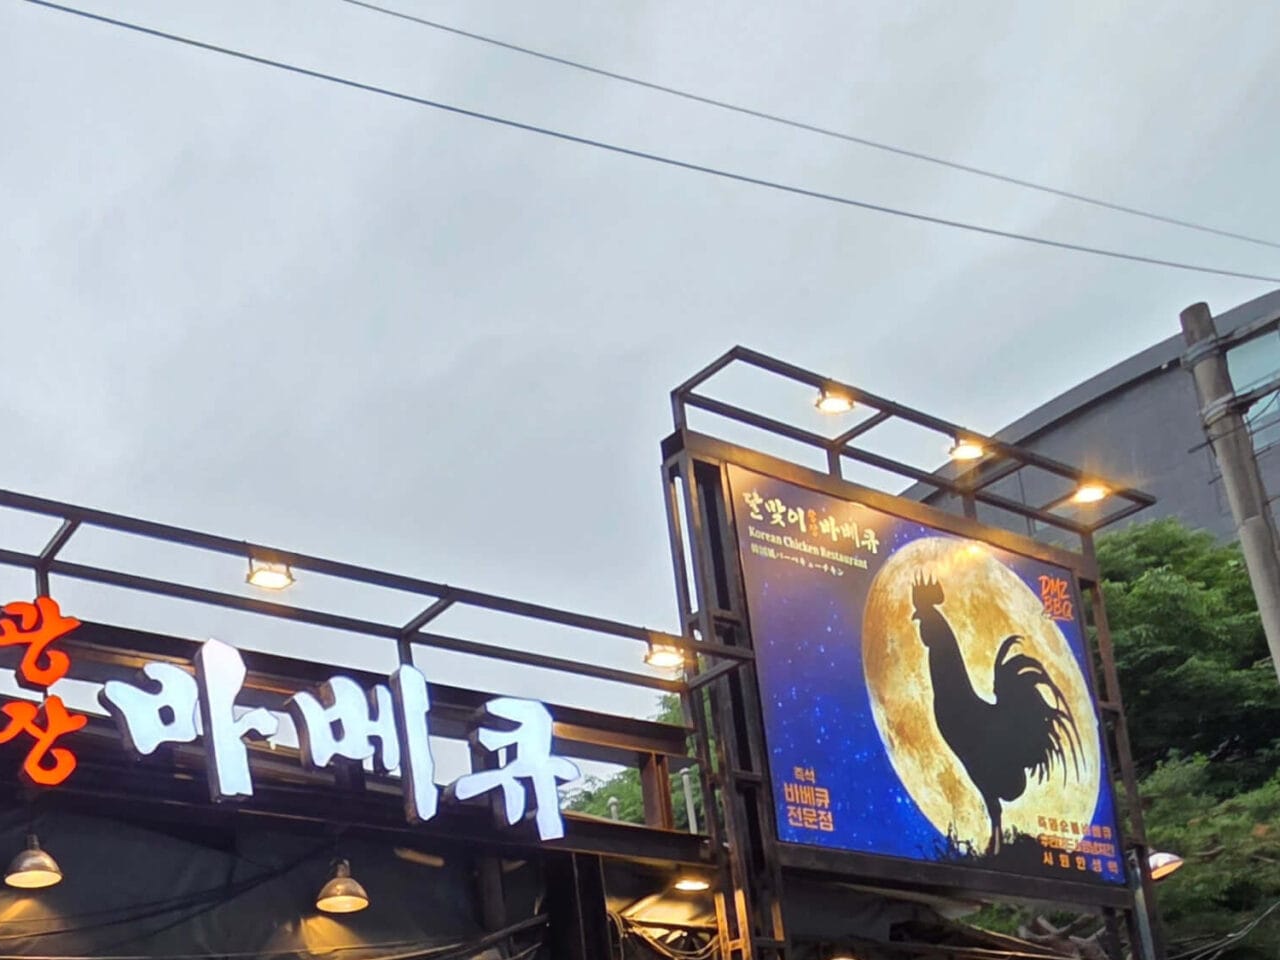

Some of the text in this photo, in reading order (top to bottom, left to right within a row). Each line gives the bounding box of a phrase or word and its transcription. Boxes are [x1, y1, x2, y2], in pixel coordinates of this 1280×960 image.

[742, 489, 806, 533] 달맞이
[748, 525, 868, 570] Korean Chicken Restaurant
[1038, 574, 1070, 599] DMZ
[1043, 595, 1074, 619] BBQ
[784, 783, 830, 809] 바베큐
[786, 805, 834, 832] 전문점
